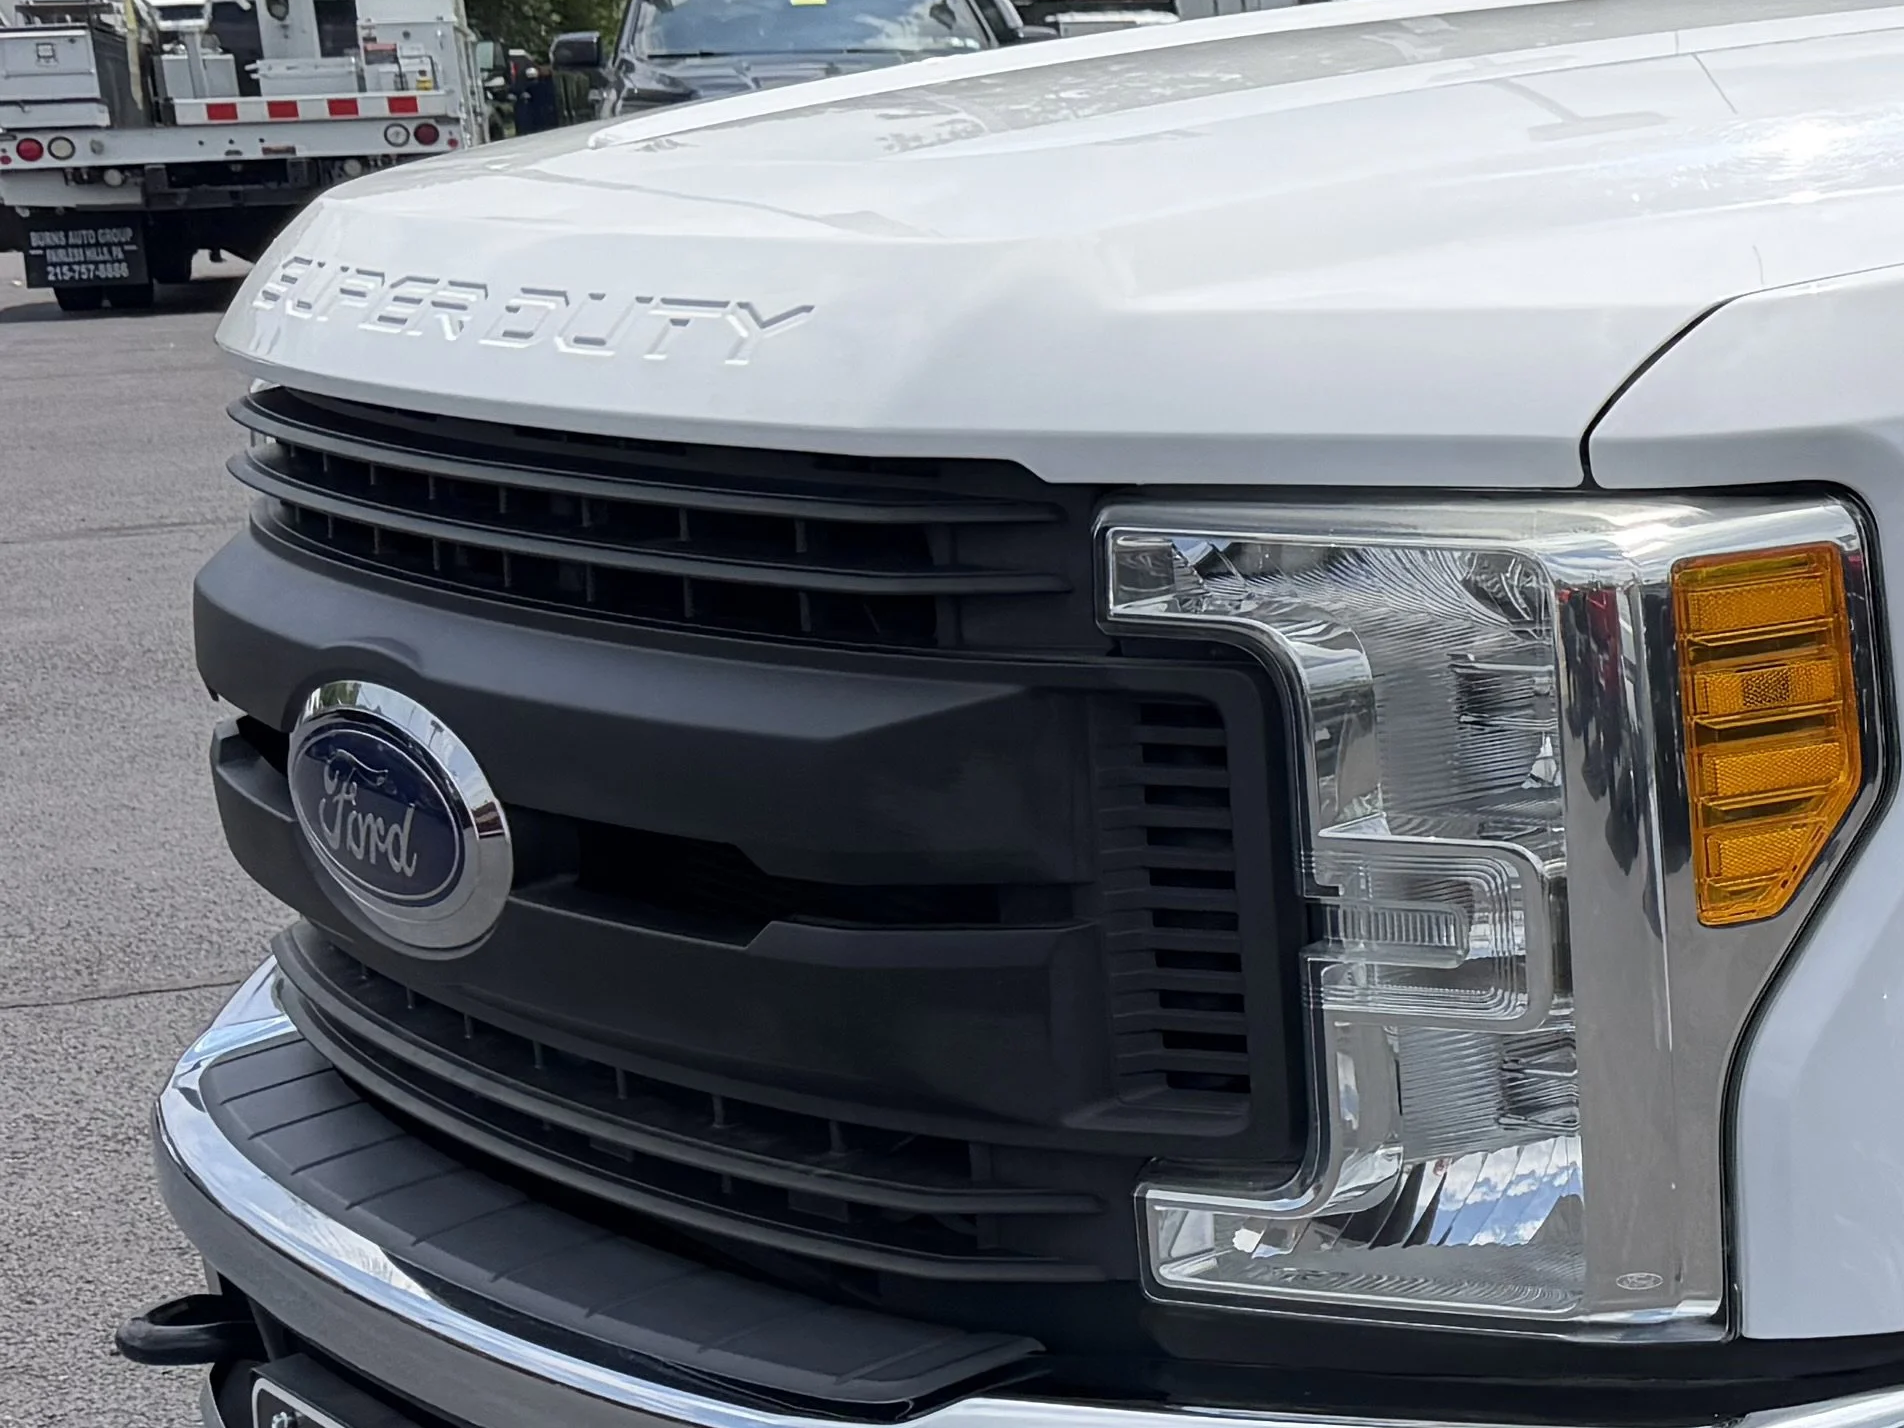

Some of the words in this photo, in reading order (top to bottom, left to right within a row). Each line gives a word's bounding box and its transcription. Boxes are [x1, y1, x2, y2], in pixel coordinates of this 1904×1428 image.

[68, 229, 96, 245] AUTO
[97, 227, 133, 244] GROUP
[252, 256, 488, 342] SUPER
[479, 285, 816, 366] DUTY
[318, 748, 419, 878] Ford
